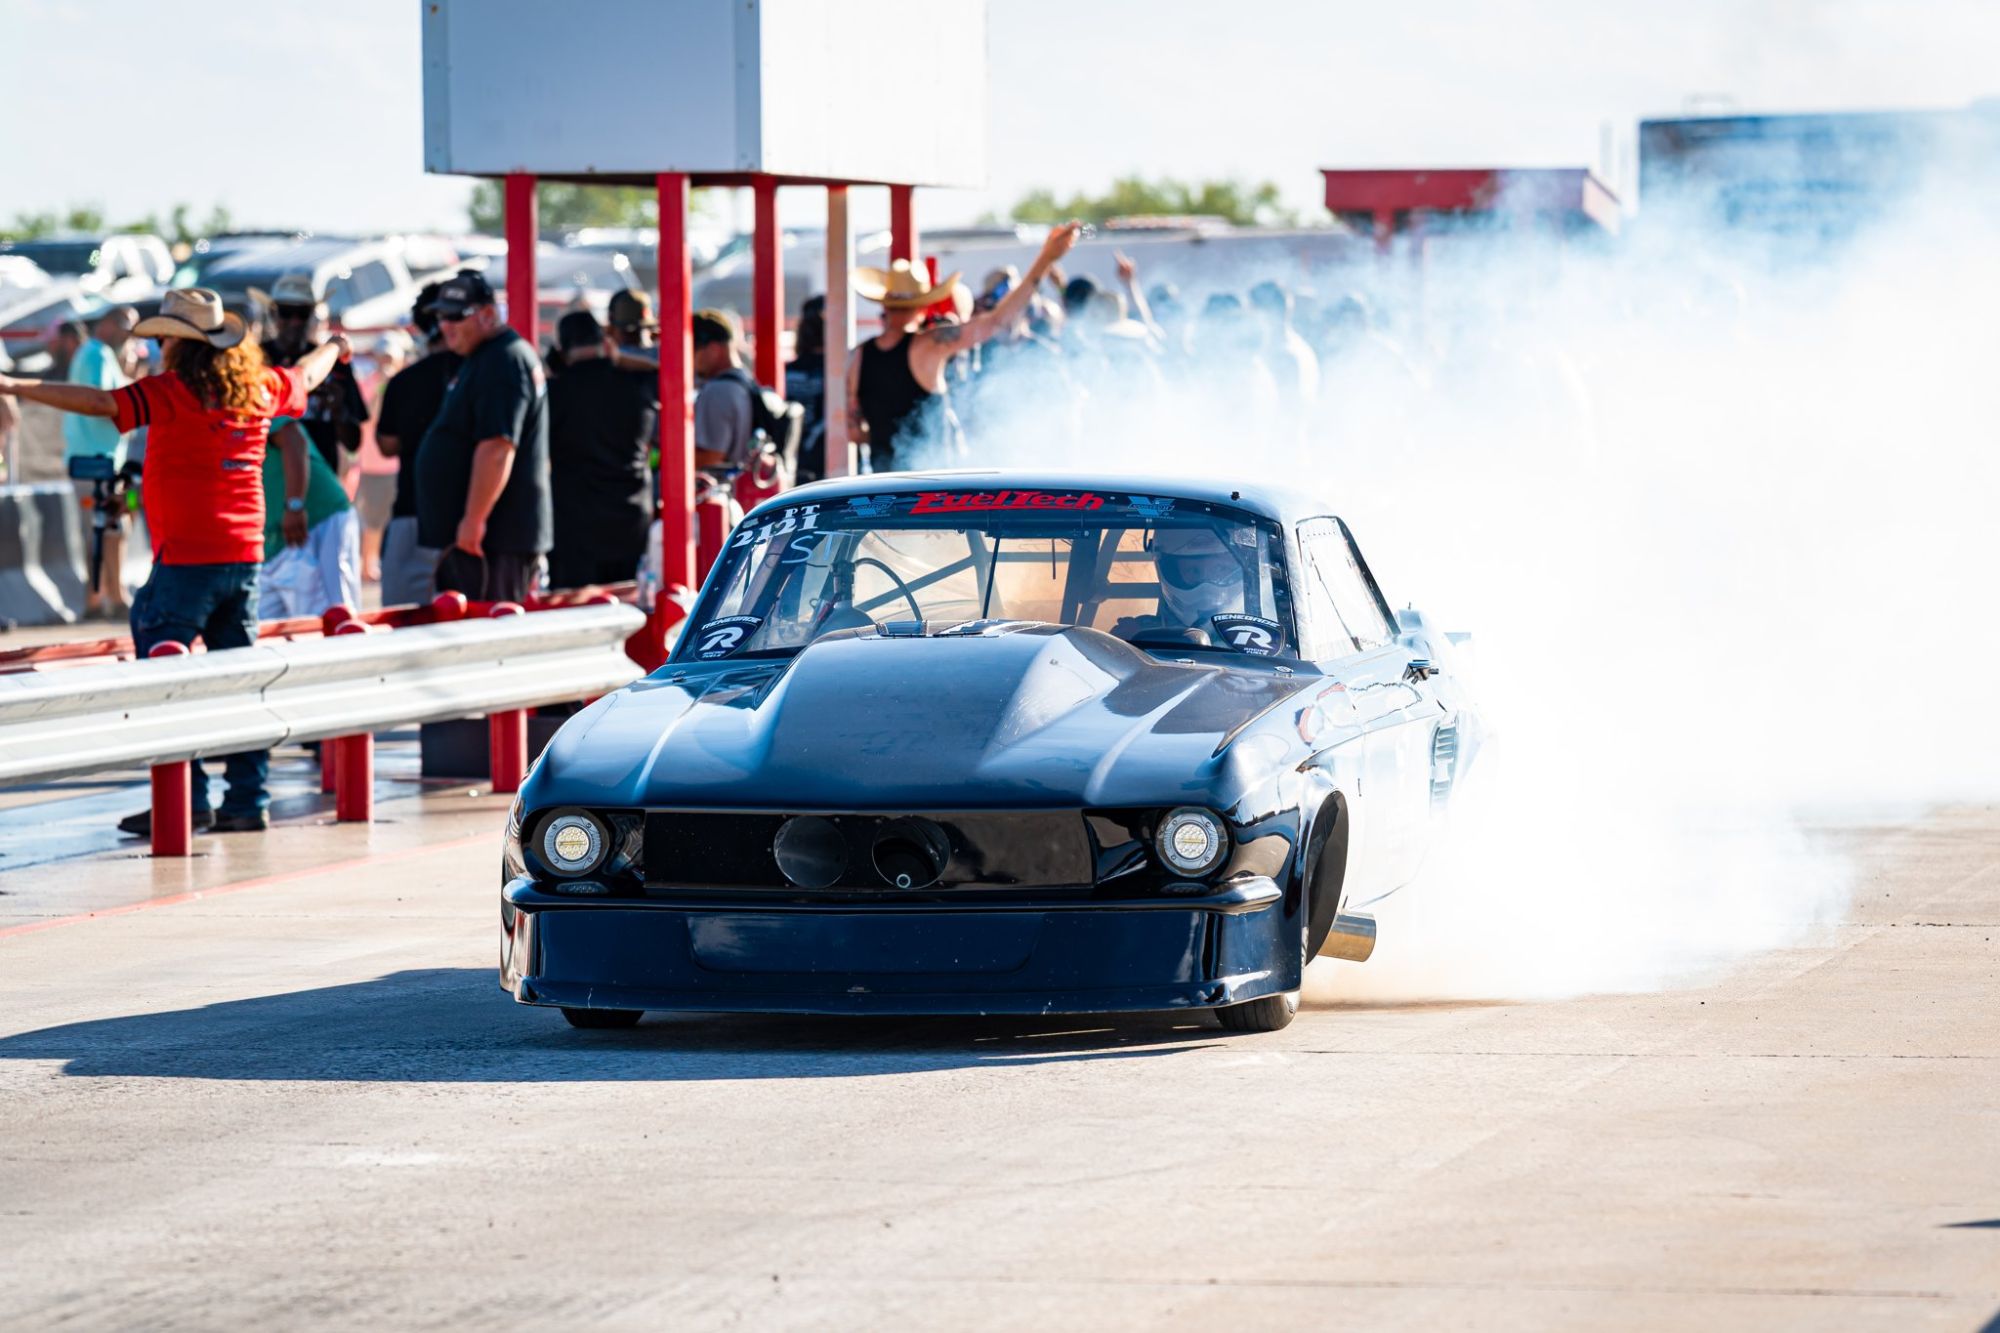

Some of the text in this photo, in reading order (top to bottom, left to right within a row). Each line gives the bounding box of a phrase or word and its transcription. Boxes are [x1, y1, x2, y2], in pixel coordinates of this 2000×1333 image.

[783, 504, 821, 520] PT
[908, 490, 1105, 514] FuelTech
[731, 513, 821, 548] 2121
[701, 616, 761, 630] RENEGADE
[1213, 614, 1281, 628] RENEGADE
[699, 626, 744, 652] R
[1224, 625, 1275, 650] R
